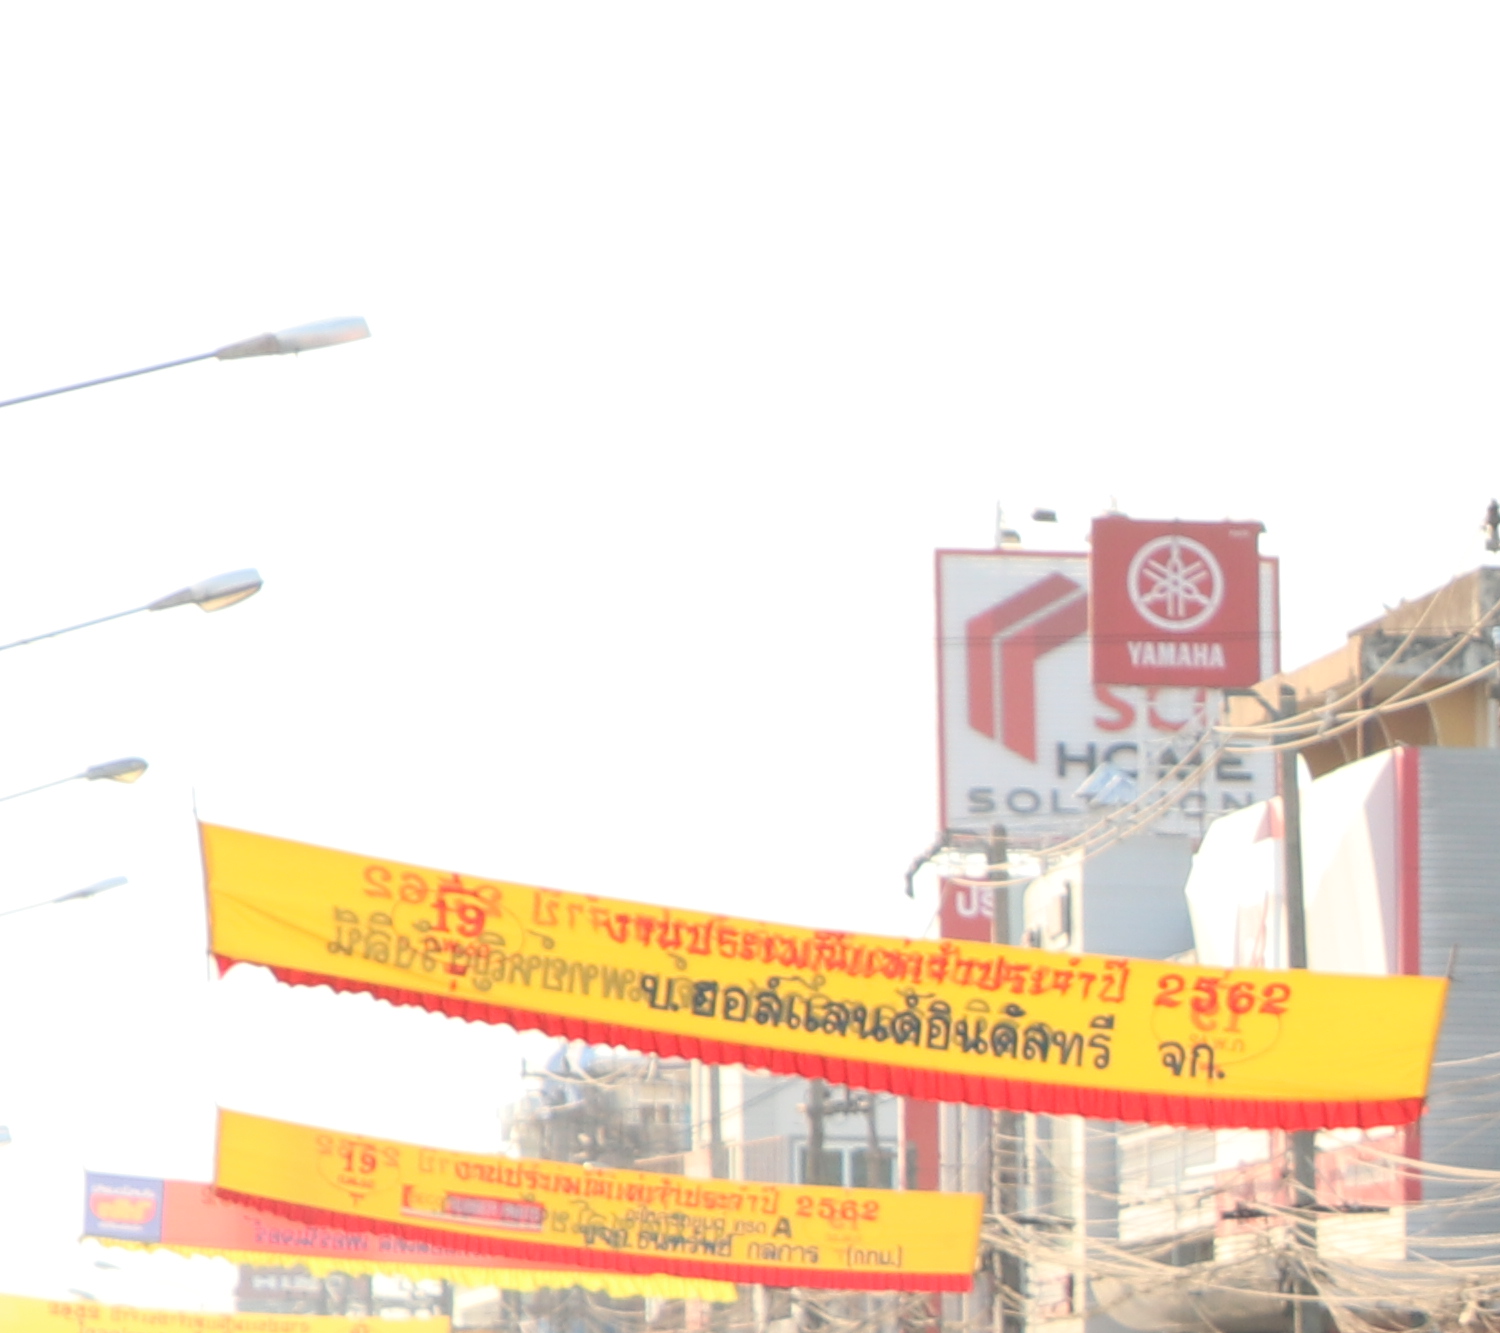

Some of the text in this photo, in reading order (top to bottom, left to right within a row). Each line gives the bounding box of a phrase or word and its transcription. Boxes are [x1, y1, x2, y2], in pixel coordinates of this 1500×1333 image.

[1127, 641, 1225, 668] YAMAHA
[1154, 973, 1291, 1015] 2562
[1158, 1041, 1226, 1080] จก.
[796, 1195, 882, 1221] 2562
[773, 1217, 793, 1239] A
